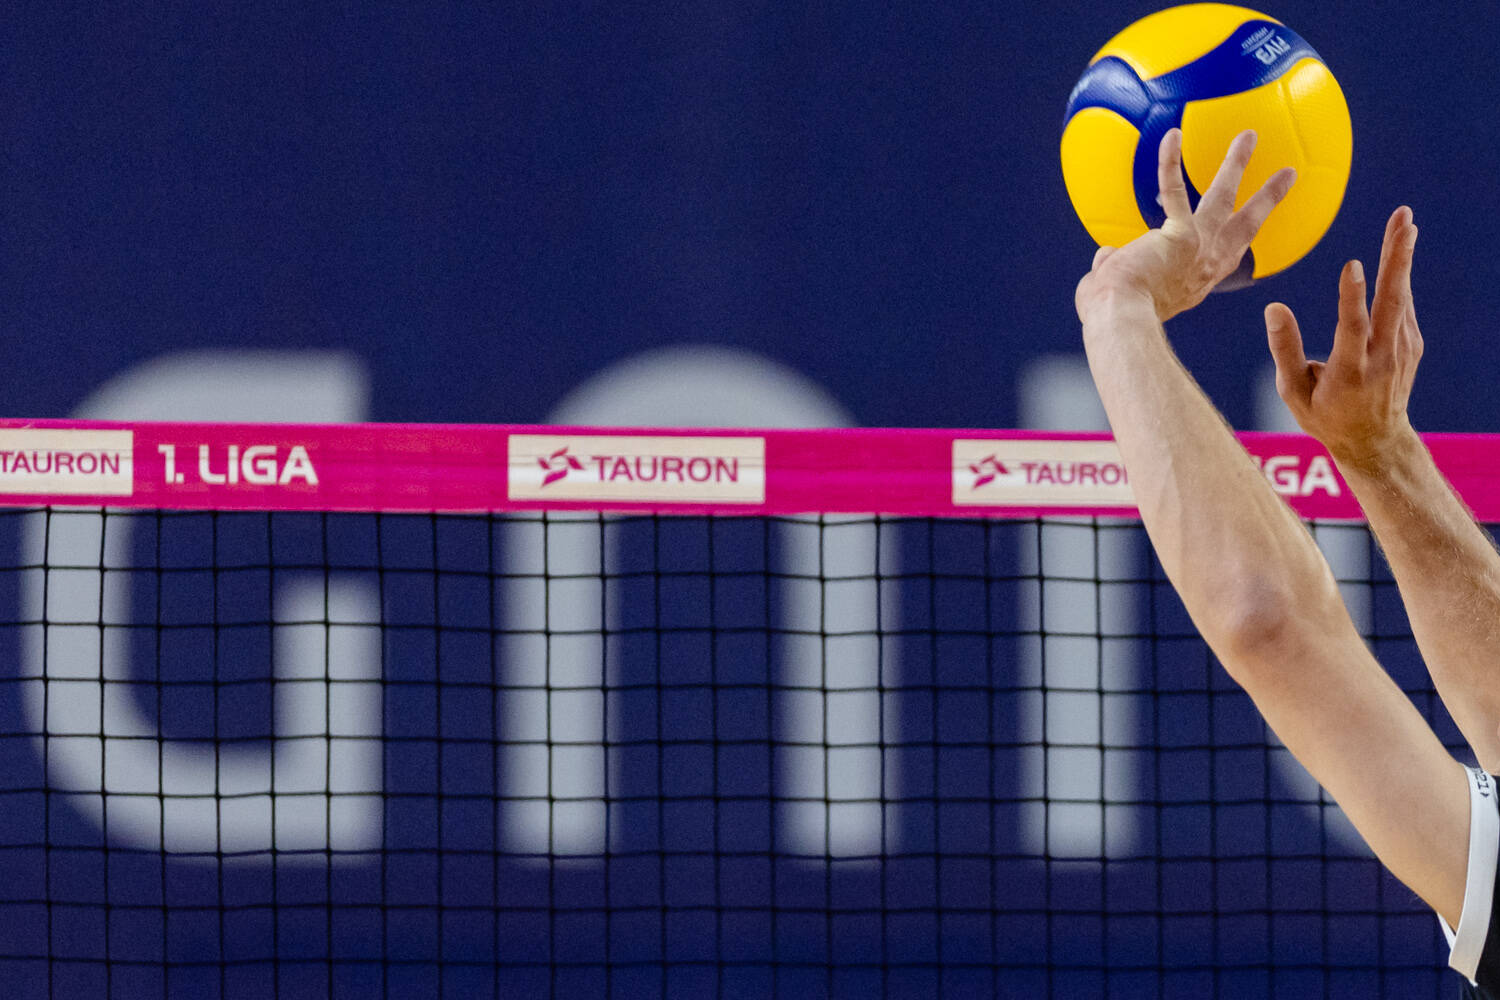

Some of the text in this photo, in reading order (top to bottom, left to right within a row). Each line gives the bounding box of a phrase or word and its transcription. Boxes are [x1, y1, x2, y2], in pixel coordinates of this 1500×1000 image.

[0, 451, 119, 474] TAURON
[158, 444, 319, 485] 1. LIGA
[591, 456, 738, 482] TAURON
[1021, 462, 1128, 485] TAURO
